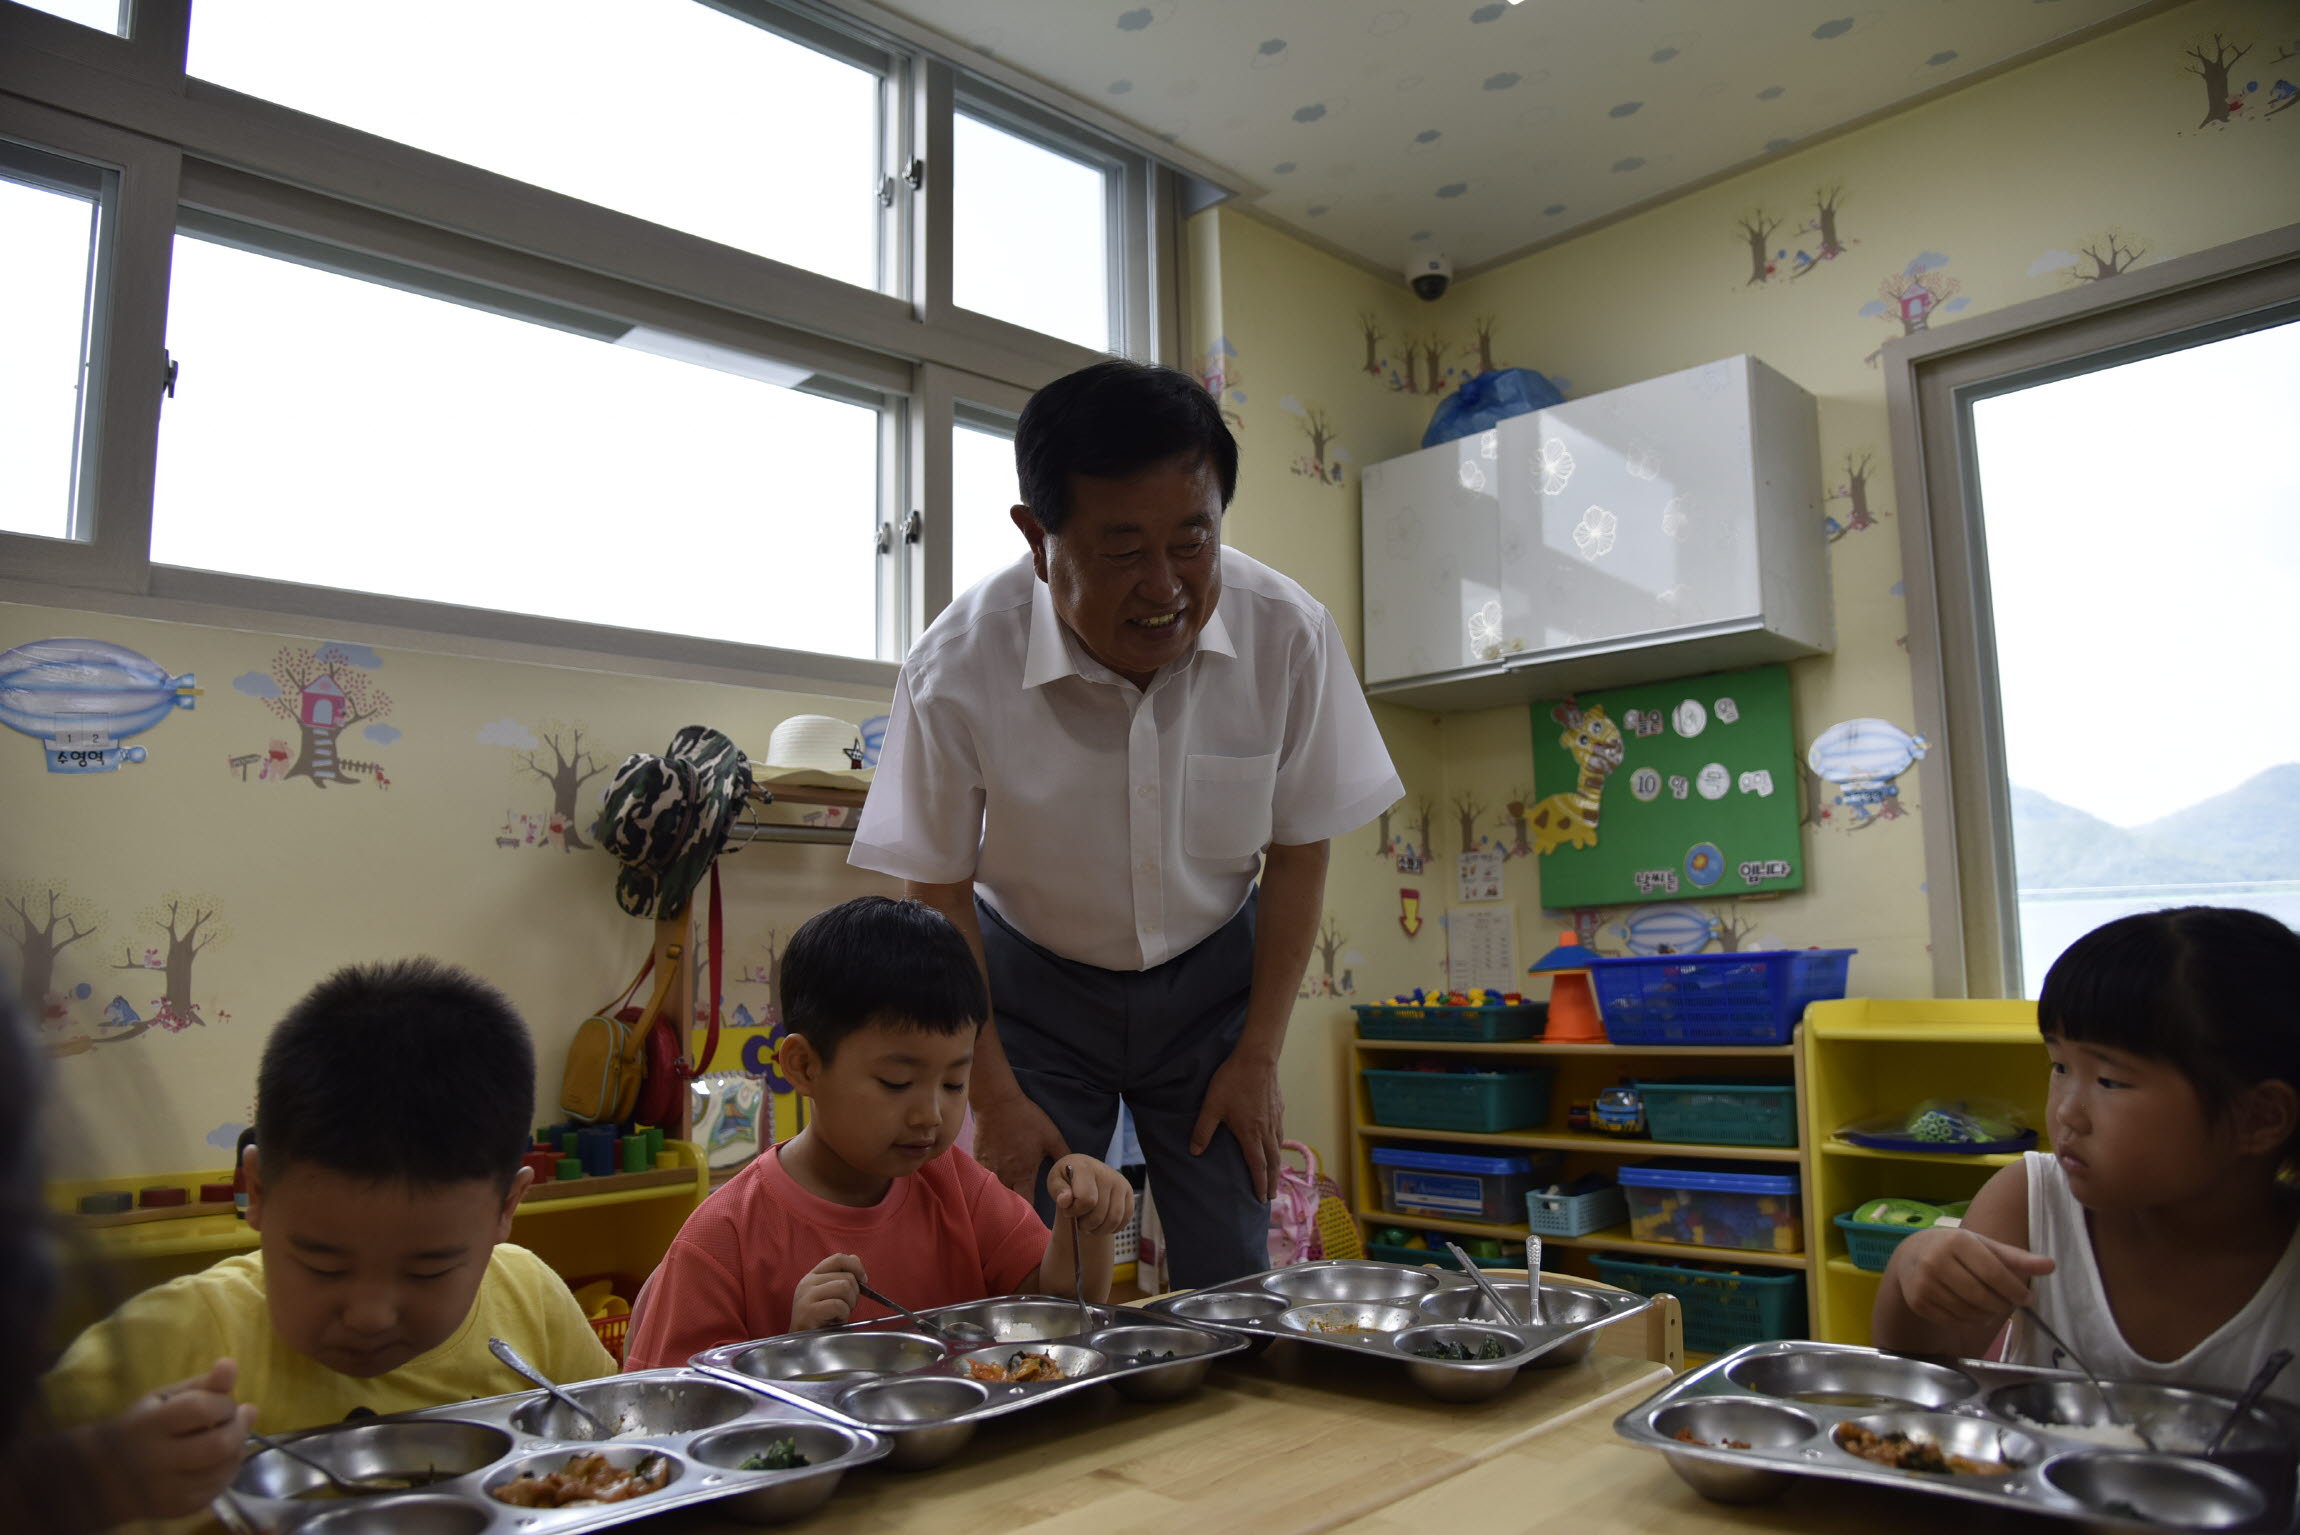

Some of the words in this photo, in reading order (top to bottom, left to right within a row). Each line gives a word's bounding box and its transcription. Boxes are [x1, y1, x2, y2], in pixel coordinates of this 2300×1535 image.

[92, 734, 99, 744] 2
[58, 750, 104, 767] 수영역
[1637, 774, 1656, 794] 10
[1636, 873, 1676, 891] 날씨는
[1740, 863, 1788, 882] 입니다
